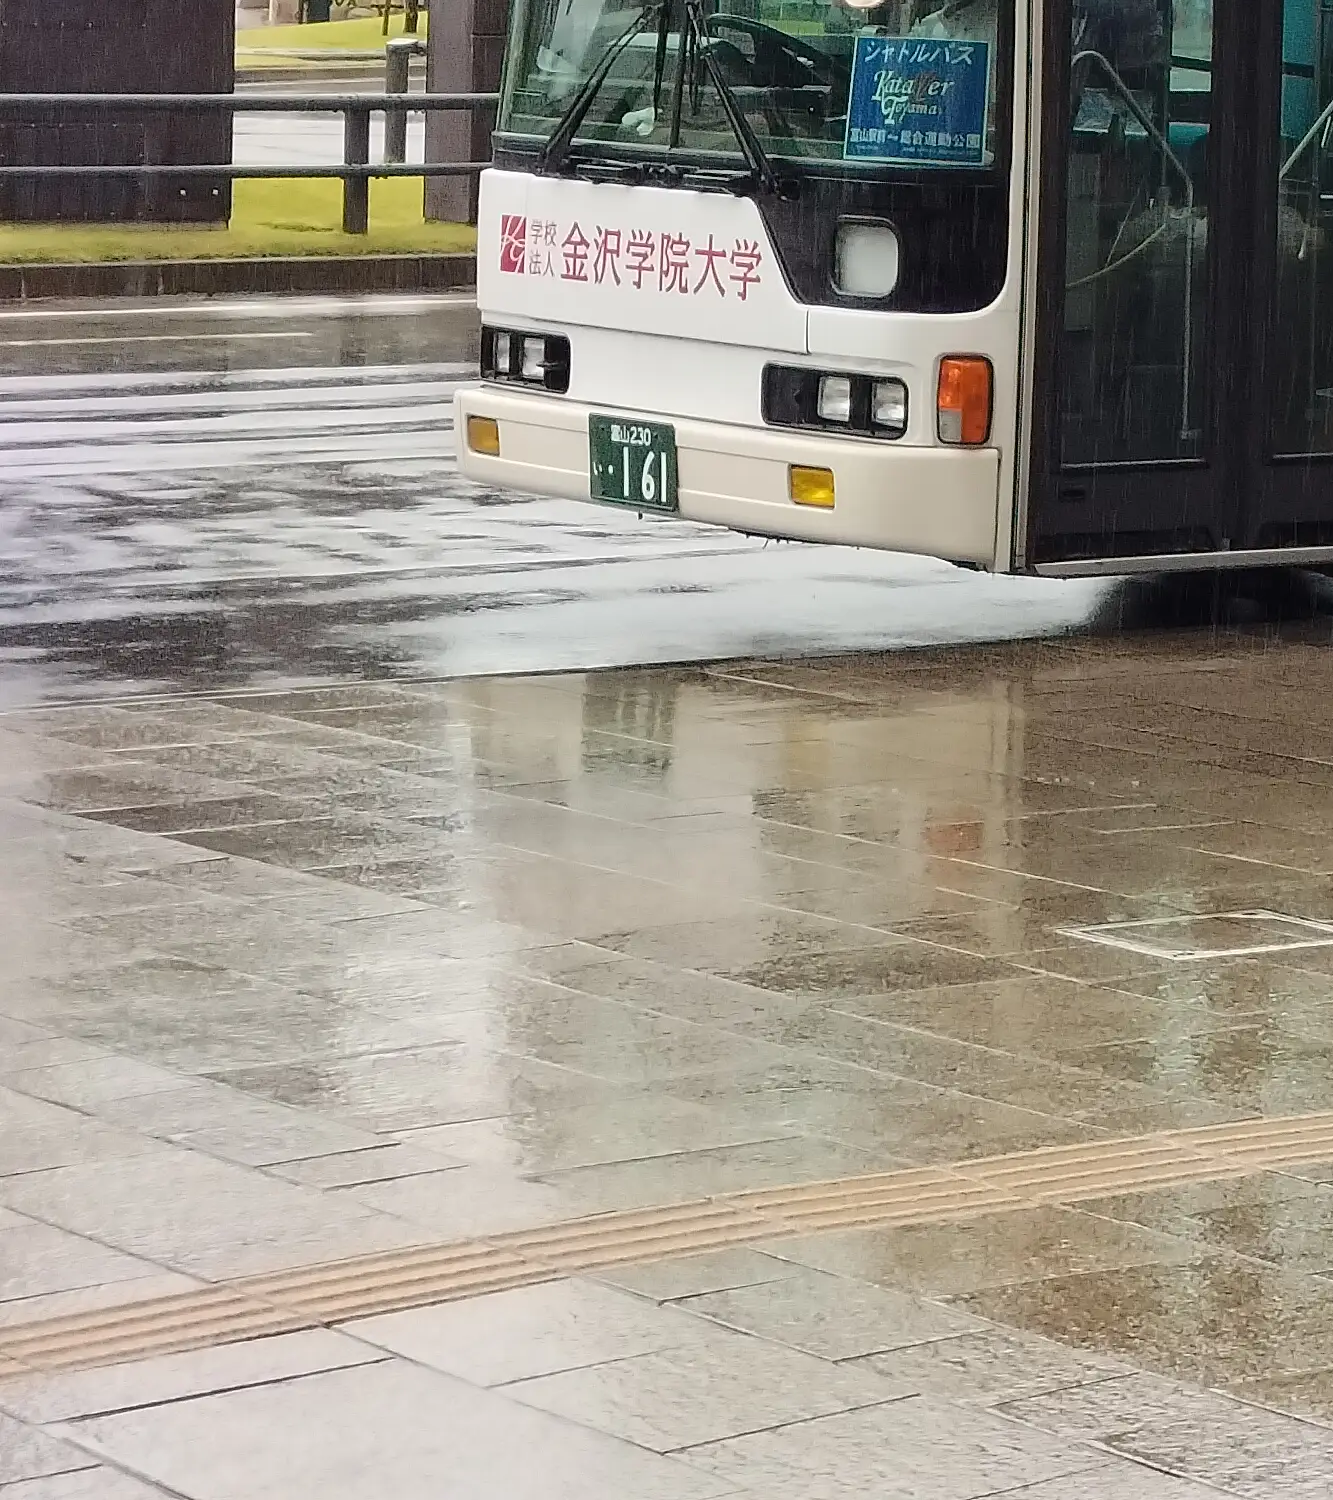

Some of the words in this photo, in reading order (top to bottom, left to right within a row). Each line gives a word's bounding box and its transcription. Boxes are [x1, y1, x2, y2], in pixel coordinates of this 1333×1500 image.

[864, 41, 975, 65] シャトルバス
[529, 219, 558, 247] 学校
[528, 250, 556, 278] 法人
[560, 221, 762, 301] 金沢学院大学
